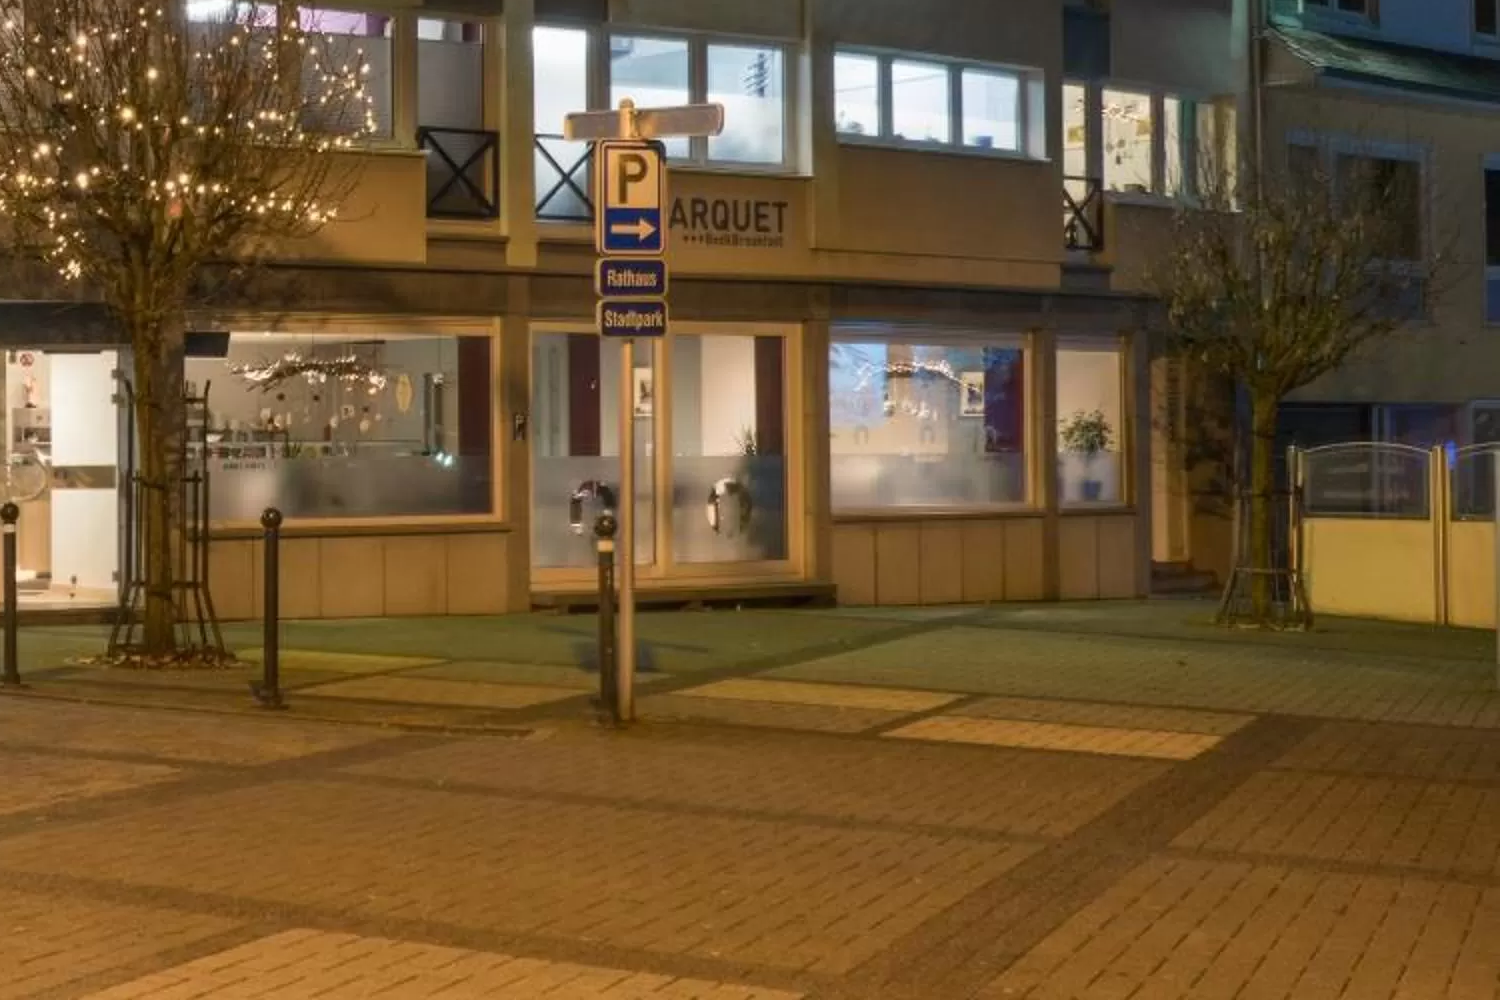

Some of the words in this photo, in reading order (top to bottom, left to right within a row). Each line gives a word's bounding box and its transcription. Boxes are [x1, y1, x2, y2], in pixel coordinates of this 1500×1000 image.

[618, 153, 649, 203] P
[668, 197, 788, 233] ARQUET
[607, 268, 657, 287] Rathaus
[604, 309, 663, 332] Stadtpark
